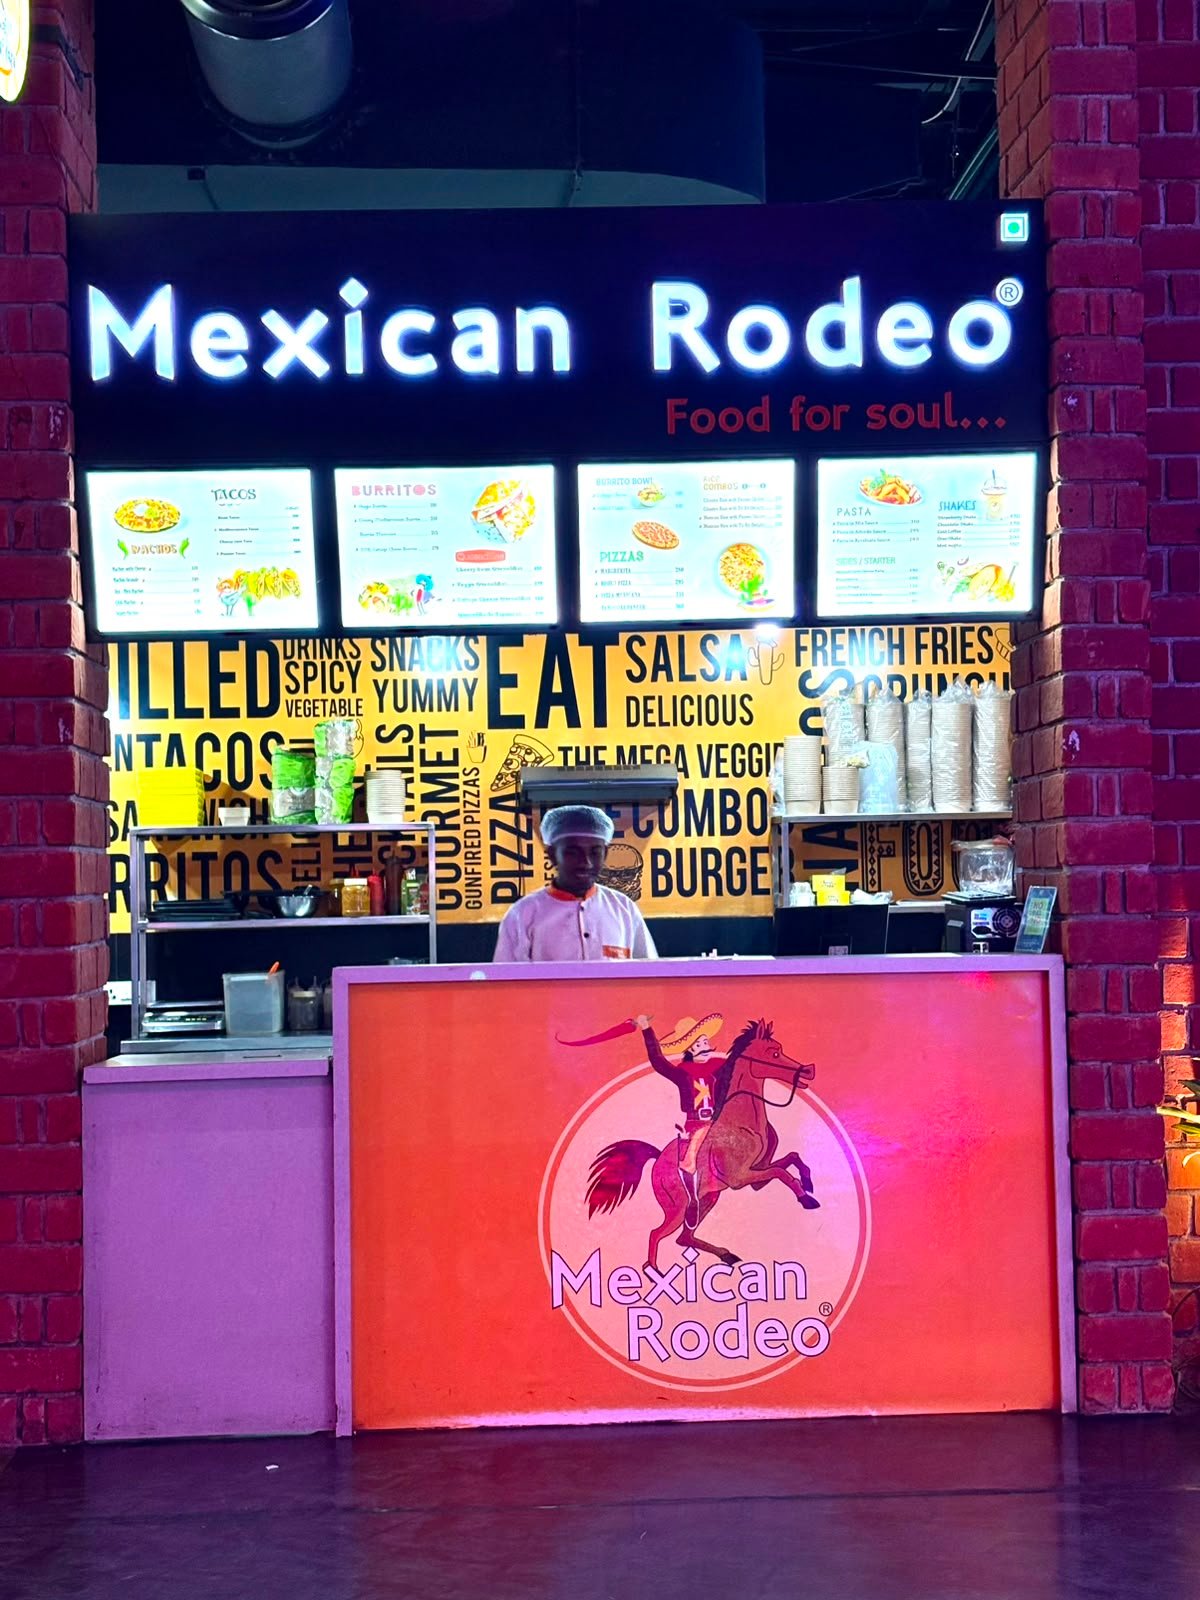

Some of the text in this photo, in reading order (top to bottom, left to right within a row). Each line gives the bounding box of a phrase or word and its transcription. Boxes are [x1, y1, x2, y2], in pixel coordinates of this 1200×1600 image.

[88, 277, 571, 382] Mexican
[651, 276, 1013, 373] Rodeo
[666, 396, 771, 435] Food
[790, 395, 849, 431] for
[211, 488, 257, 502] TACOS
[351, 484, 437, 496] BURRITOS
[938, 500, 977, 511] SHAKES
[836, 507, 872, 517] PASTA
[600, 550, 644, 563] PIZZAS
[370, 636, 480, 673] SNACKS
[625, 633, 748, 684] SALSA
[794, 625, 994, 668] FRENCH FRIES
[285, 660, 362, 695] SPICY
[372, 677, 479, 714] YUMMY
[486, 633, 620, 730] EAT
[285, 698, 364, 718] VEGETABLE
[626, 693, 754, 728] DELICIOUS
[461, 766, 483, 910] GUNFIRED PIZZAS
[551, 1246, 807, 1310] Mexican
[627, 1302, 831, 1364] Rodeo
